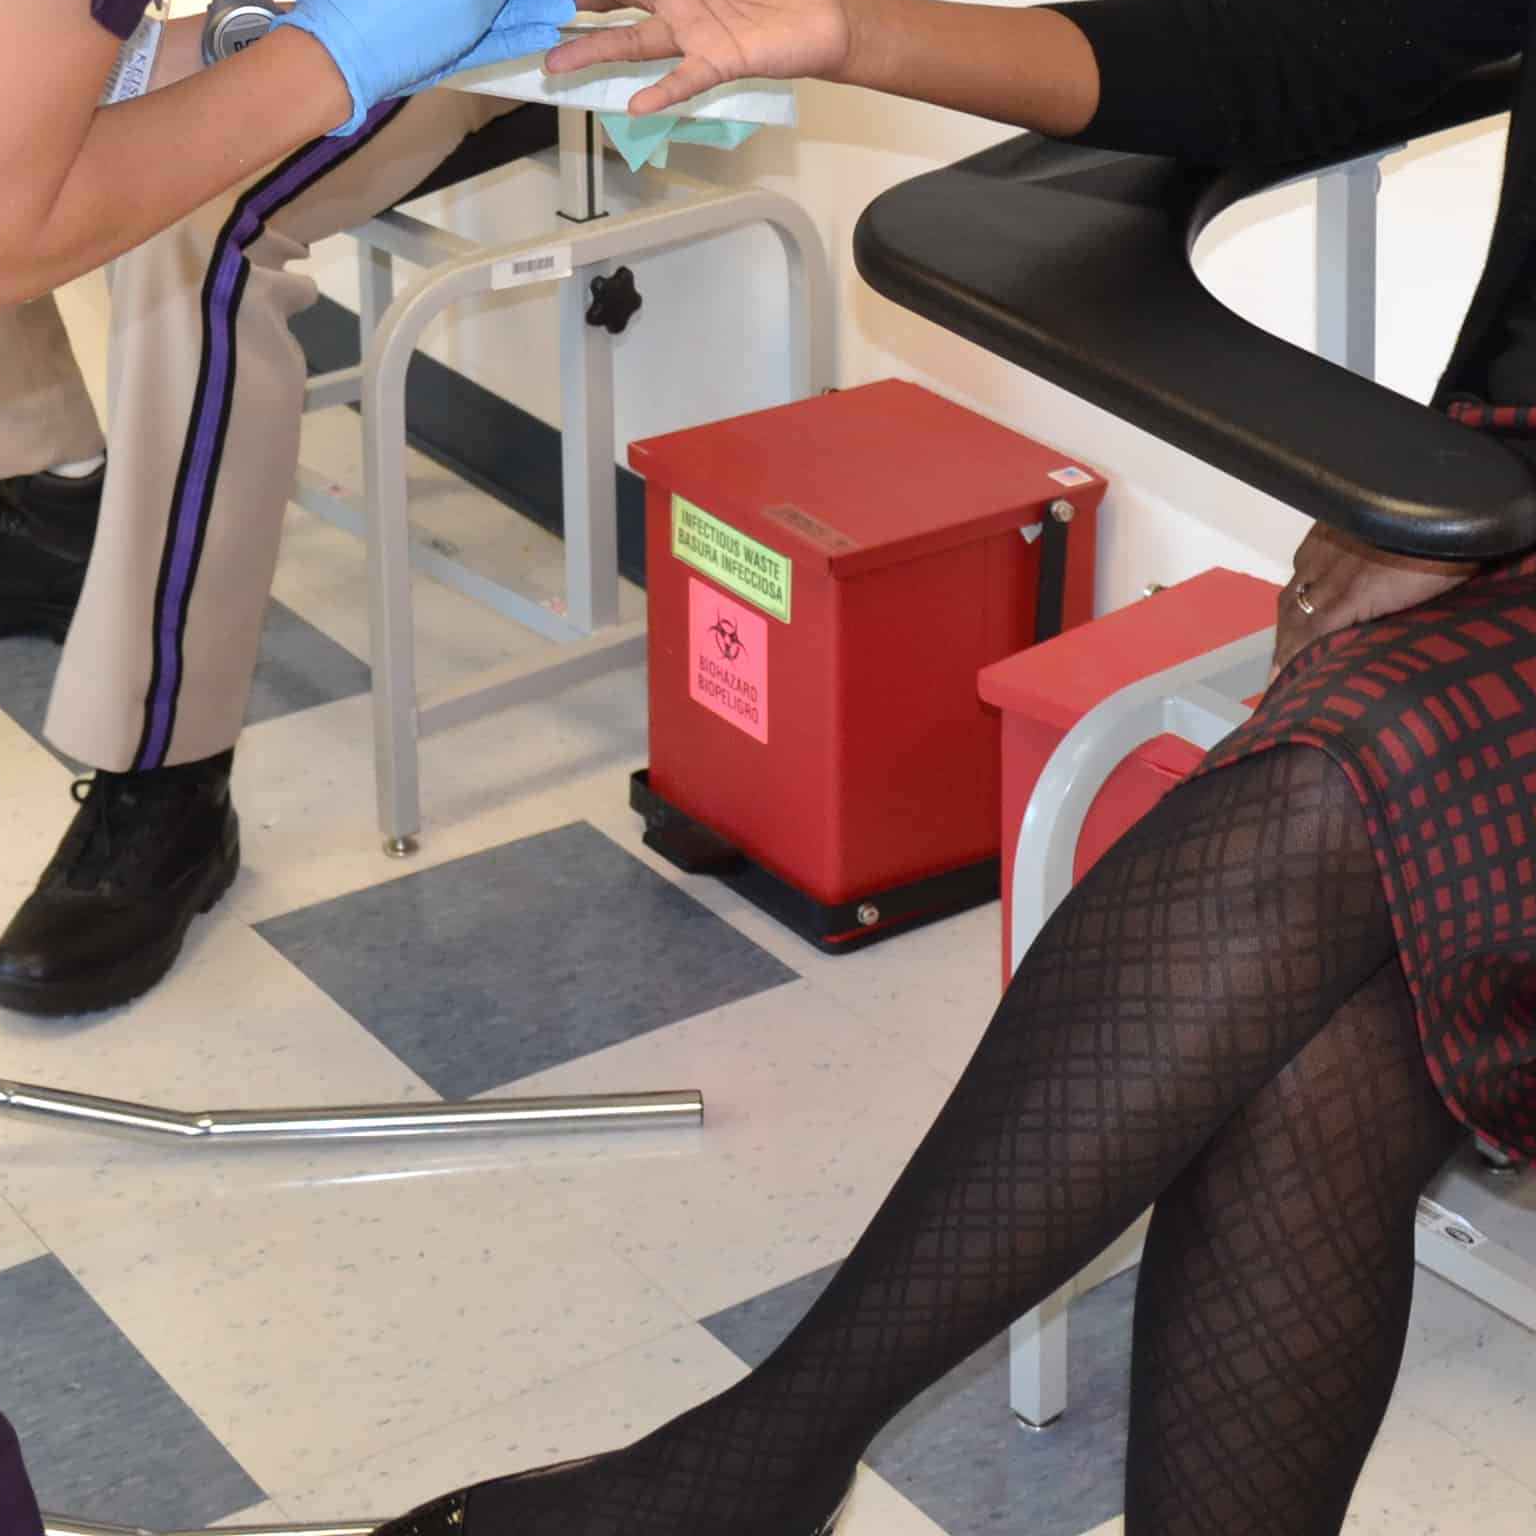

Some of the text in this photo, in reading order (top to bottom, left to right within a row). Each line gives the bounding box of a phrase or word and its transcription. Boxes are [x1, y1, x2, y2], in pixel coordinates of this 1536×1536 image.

[677, 527, 784, 605] BASURA INFECCIOSA
[681, 508, 741, 558] INFECTIOUS
[743, 543, 780, 581] WASTE
[698, 672, 760, 725] BIOPELIGRO
[699, 655, 758, 703] BIOHAZARD
